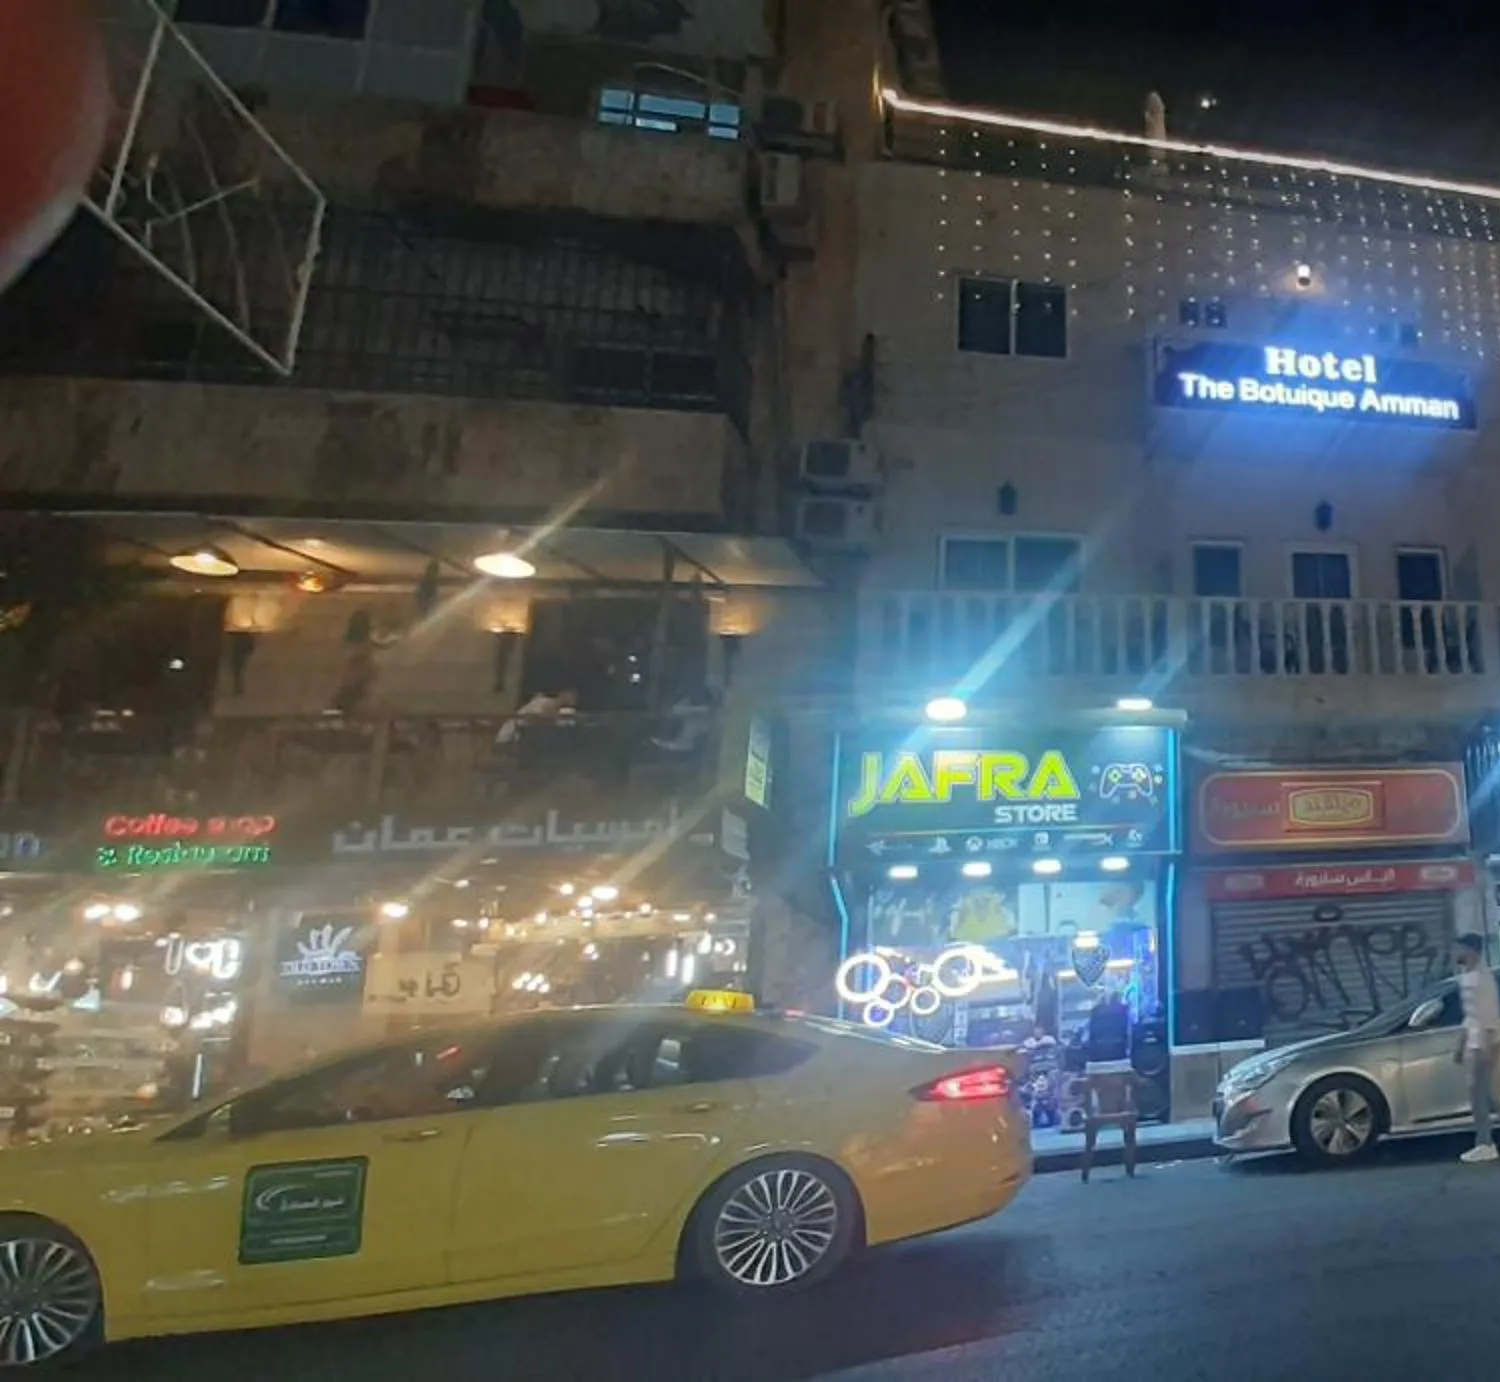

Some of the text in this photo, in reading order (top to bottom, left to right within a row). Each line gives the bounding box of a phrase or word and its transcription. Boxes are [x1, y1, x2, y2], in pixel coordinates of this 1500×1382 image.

[1264, 346, 1377, 383] Hotel
[1178, 372, 1460, 420] The Botuique Amman
[848, 750, 1081, 817] JAFRA
[994, 803, 1078, 824] STORE
